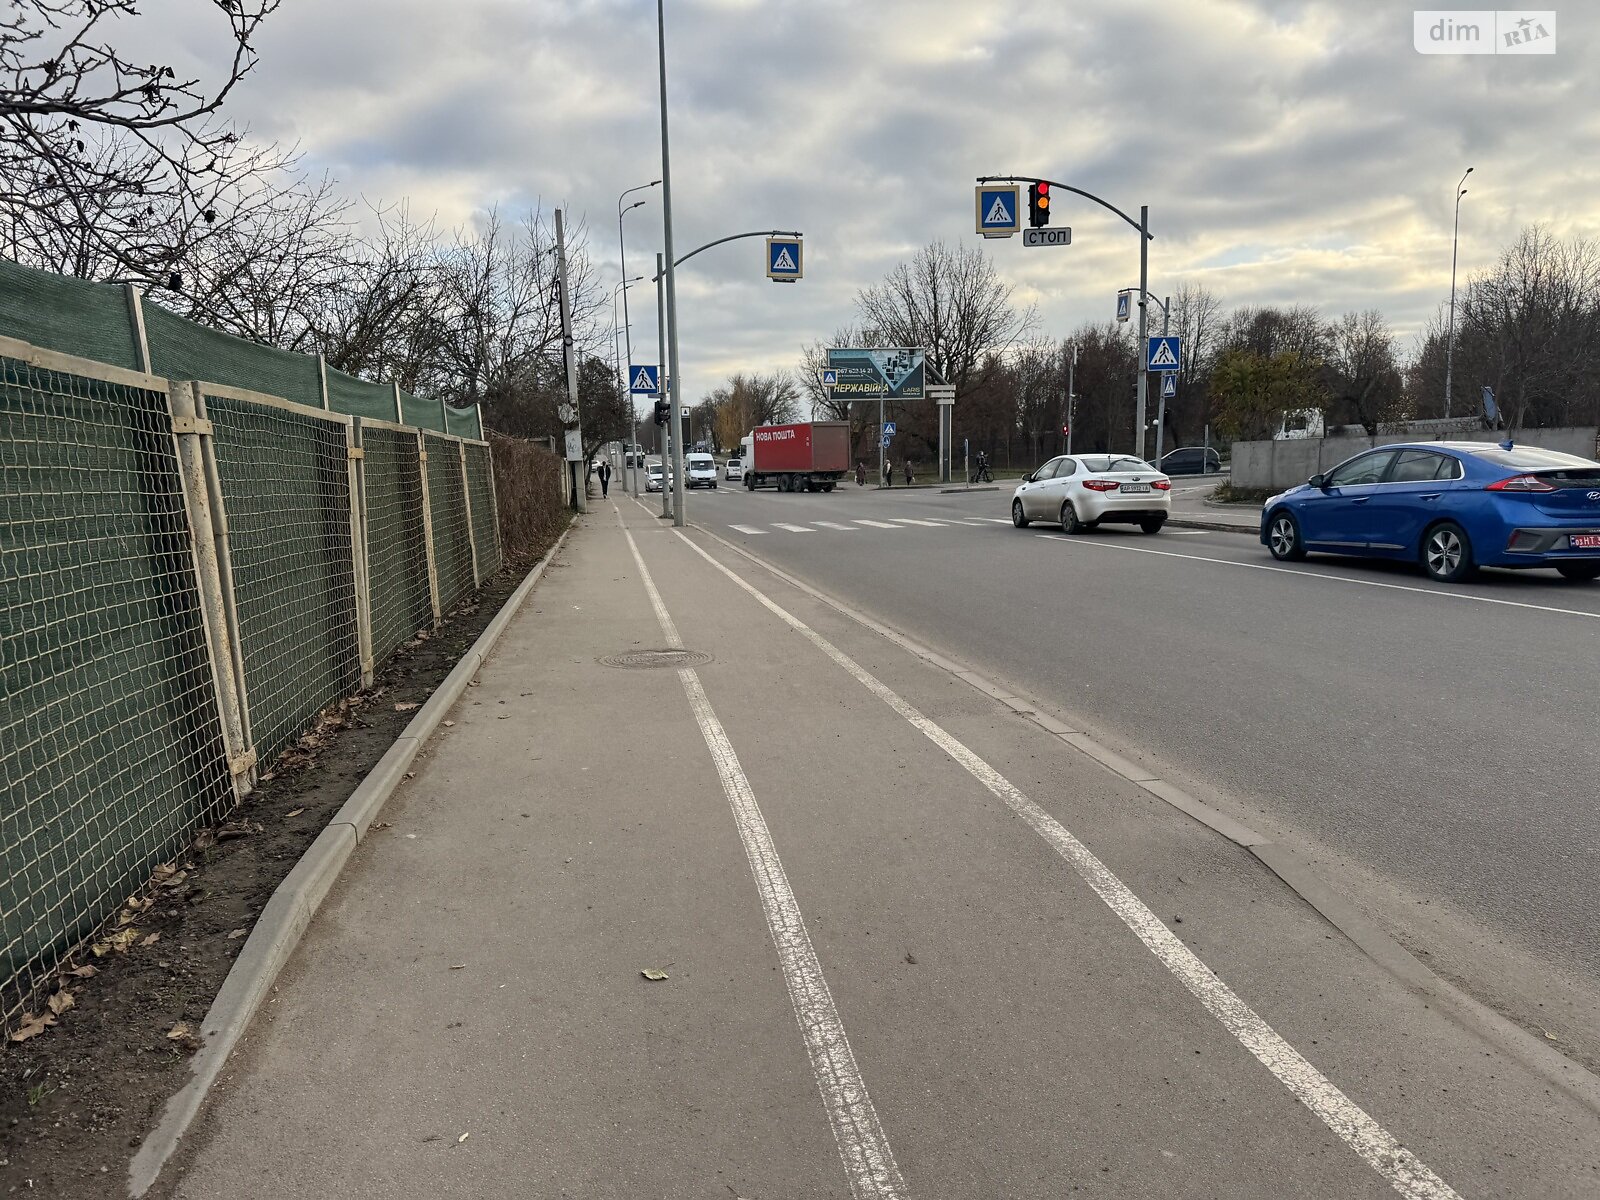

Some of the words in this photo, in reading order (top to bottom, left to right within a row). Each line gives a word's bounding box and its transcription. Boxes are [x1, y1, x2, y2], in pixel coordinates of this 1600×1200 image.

[1029, 231, 1066, 244] СТОП
[755, 431, 772, 442] НОВА
[772, 429, 796, 441] ПОШТА
